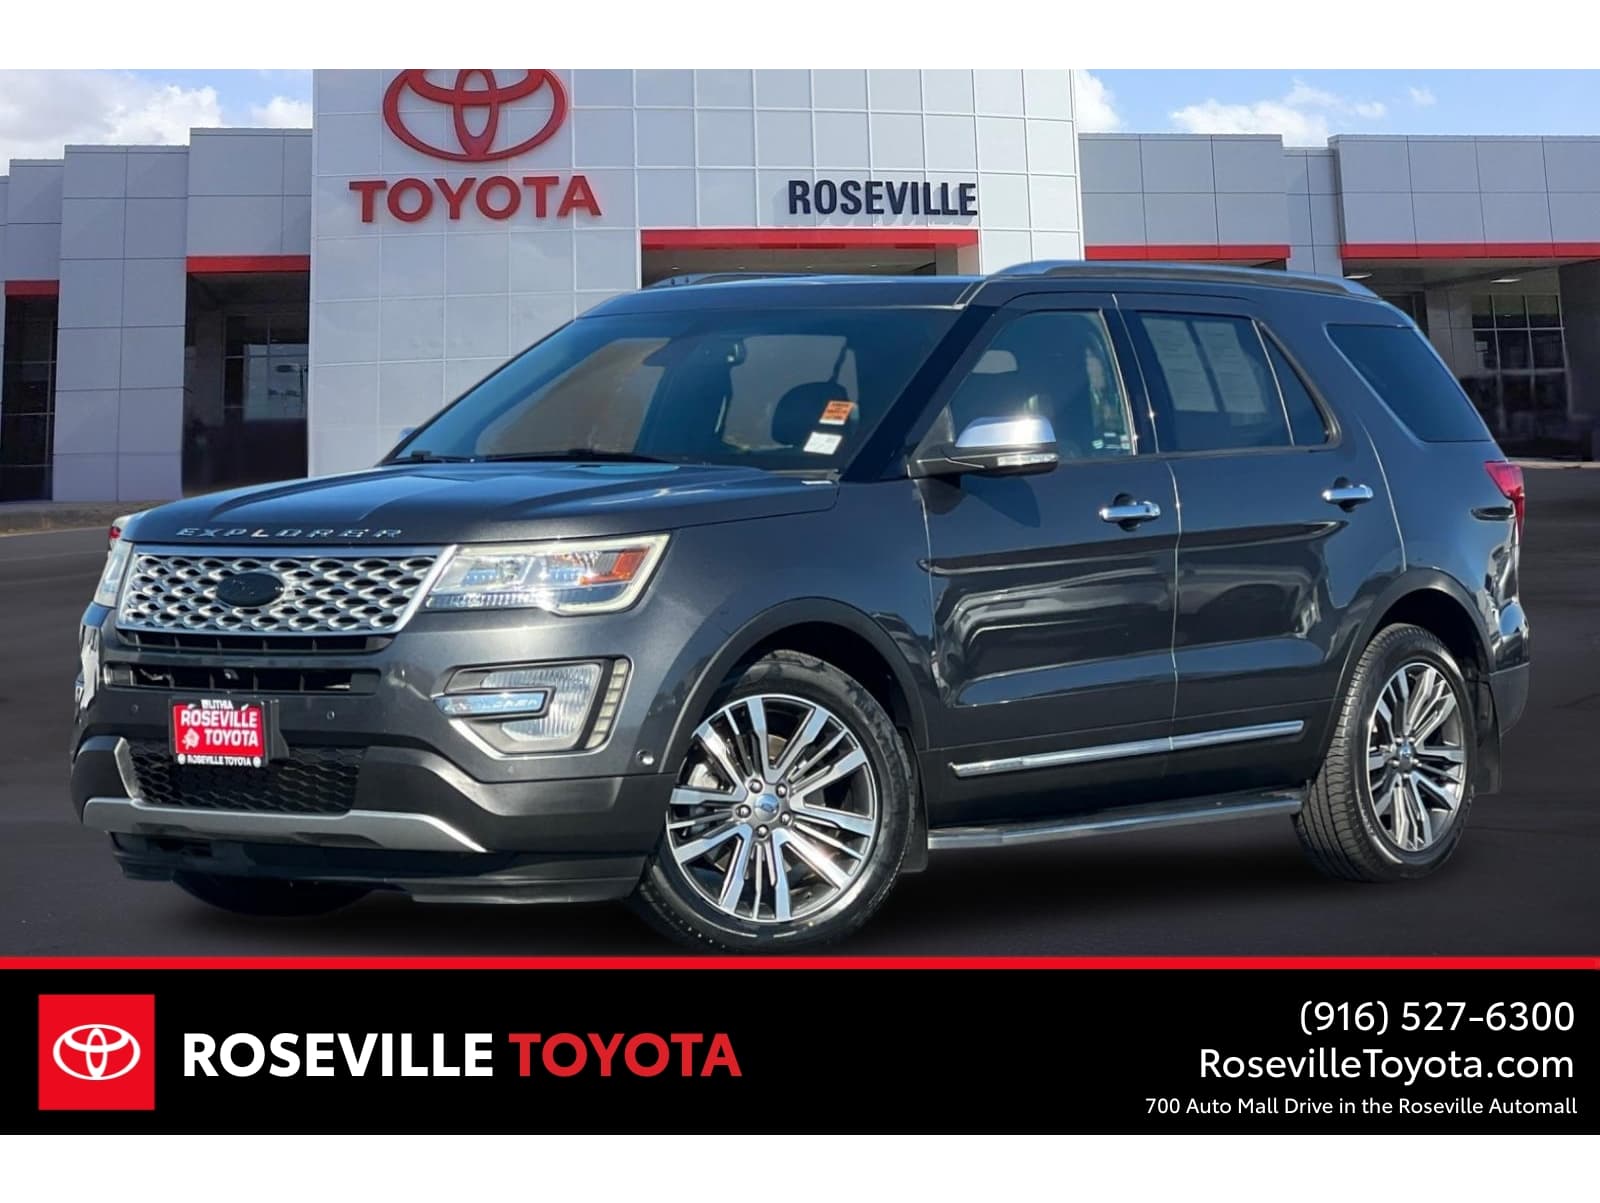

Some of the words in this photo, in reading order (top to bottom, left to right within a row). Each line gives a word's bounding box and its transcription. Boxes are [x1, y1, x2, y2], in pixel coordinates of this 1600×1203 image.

[349, 175, 601, 223] TOYOTA
[788, 179, 978, 216] ROSEVILLE
[176, 527, 402, 538] EXPLORER
[181, 710, 257, 728] ROSEVILLE
[204, 729, 258, 747] TOYOTA
[187, 755, 224, 765] ROSEVILLE
[224, 756, 252, 767] TOYOTA
